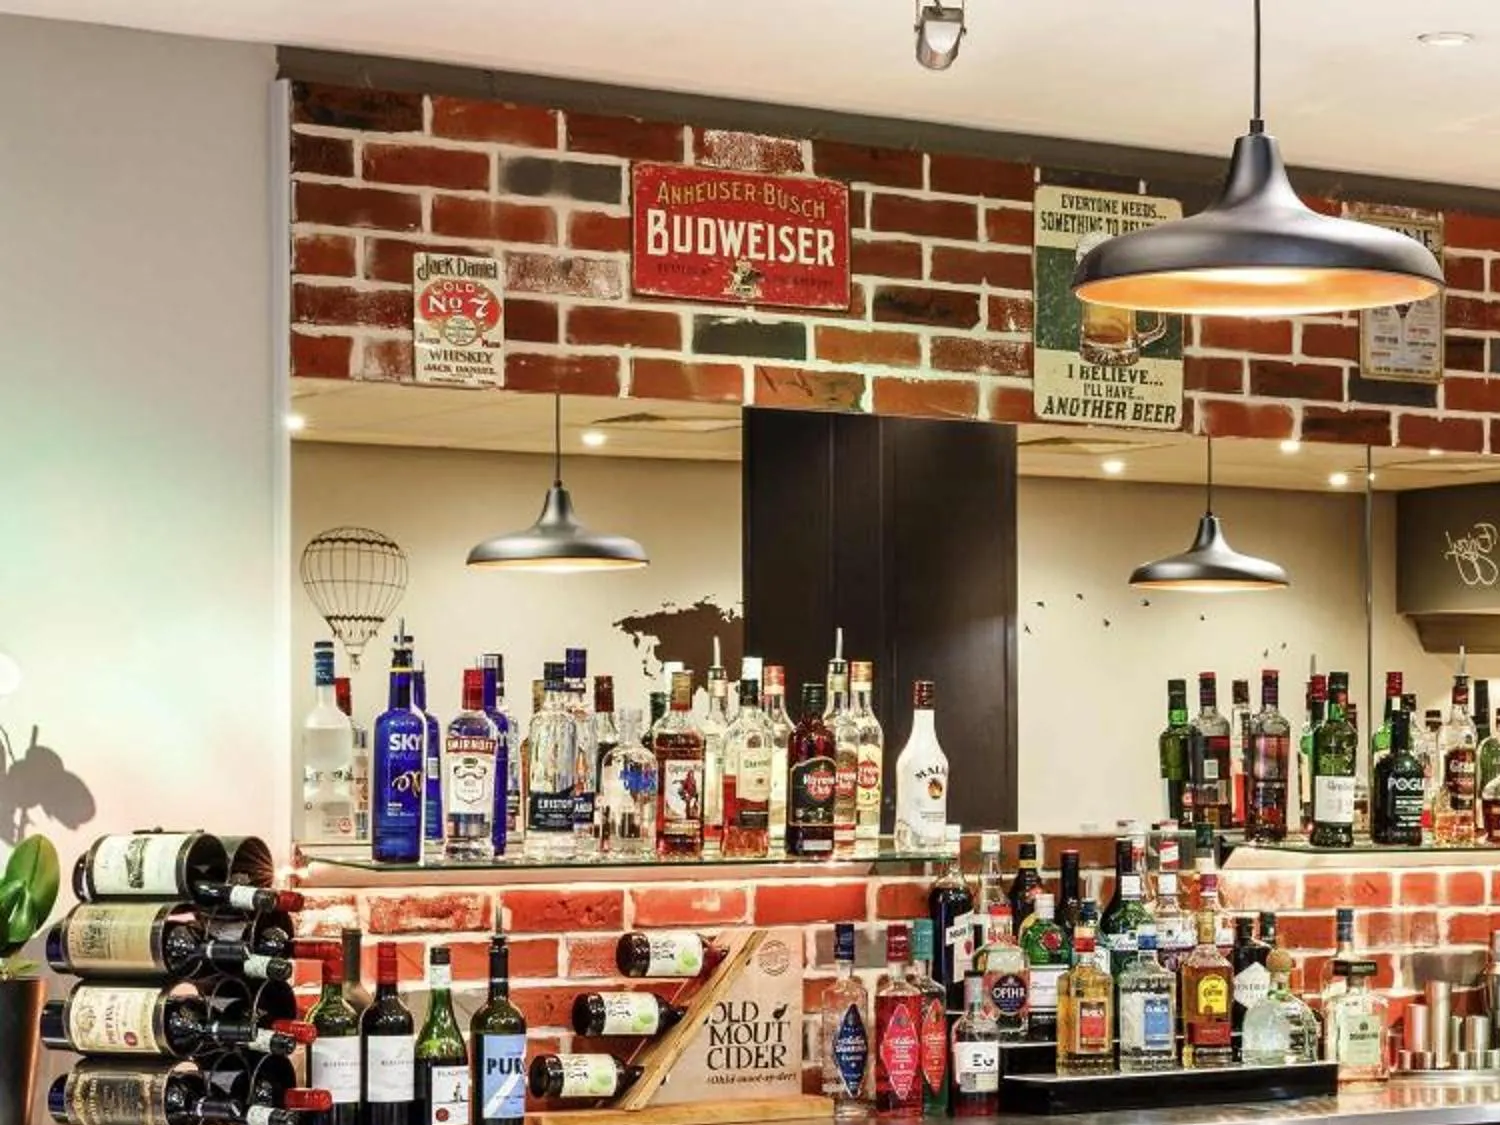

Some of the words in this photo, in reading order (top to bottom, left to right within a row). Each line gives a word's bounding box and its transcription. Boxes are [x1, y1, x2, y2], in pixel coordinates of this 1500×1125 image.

[657, 180, 826, 220] ANHEUSER-BUSCH
[1060, 193, 1119, 214] EVERYONE
[1040, 211, 1102, 235] SOMETHING
[1106, 217, 1119, 237] TO
[647, 208, 835, 267] BUDWEISER
[443, 281, 476, 293] OLD
[468, 297, 490, 318] 7
[428, 349, 494, 364] WHISKEY
[1067, 363, 1073, 379] I
[1042, 395, 1127, 421] ANOTHER
[1132, 401, 1177, 424] BEER
[709, 1022, 790, 1046] MOUT
[706, 1044, 787, 1071] CIDER
